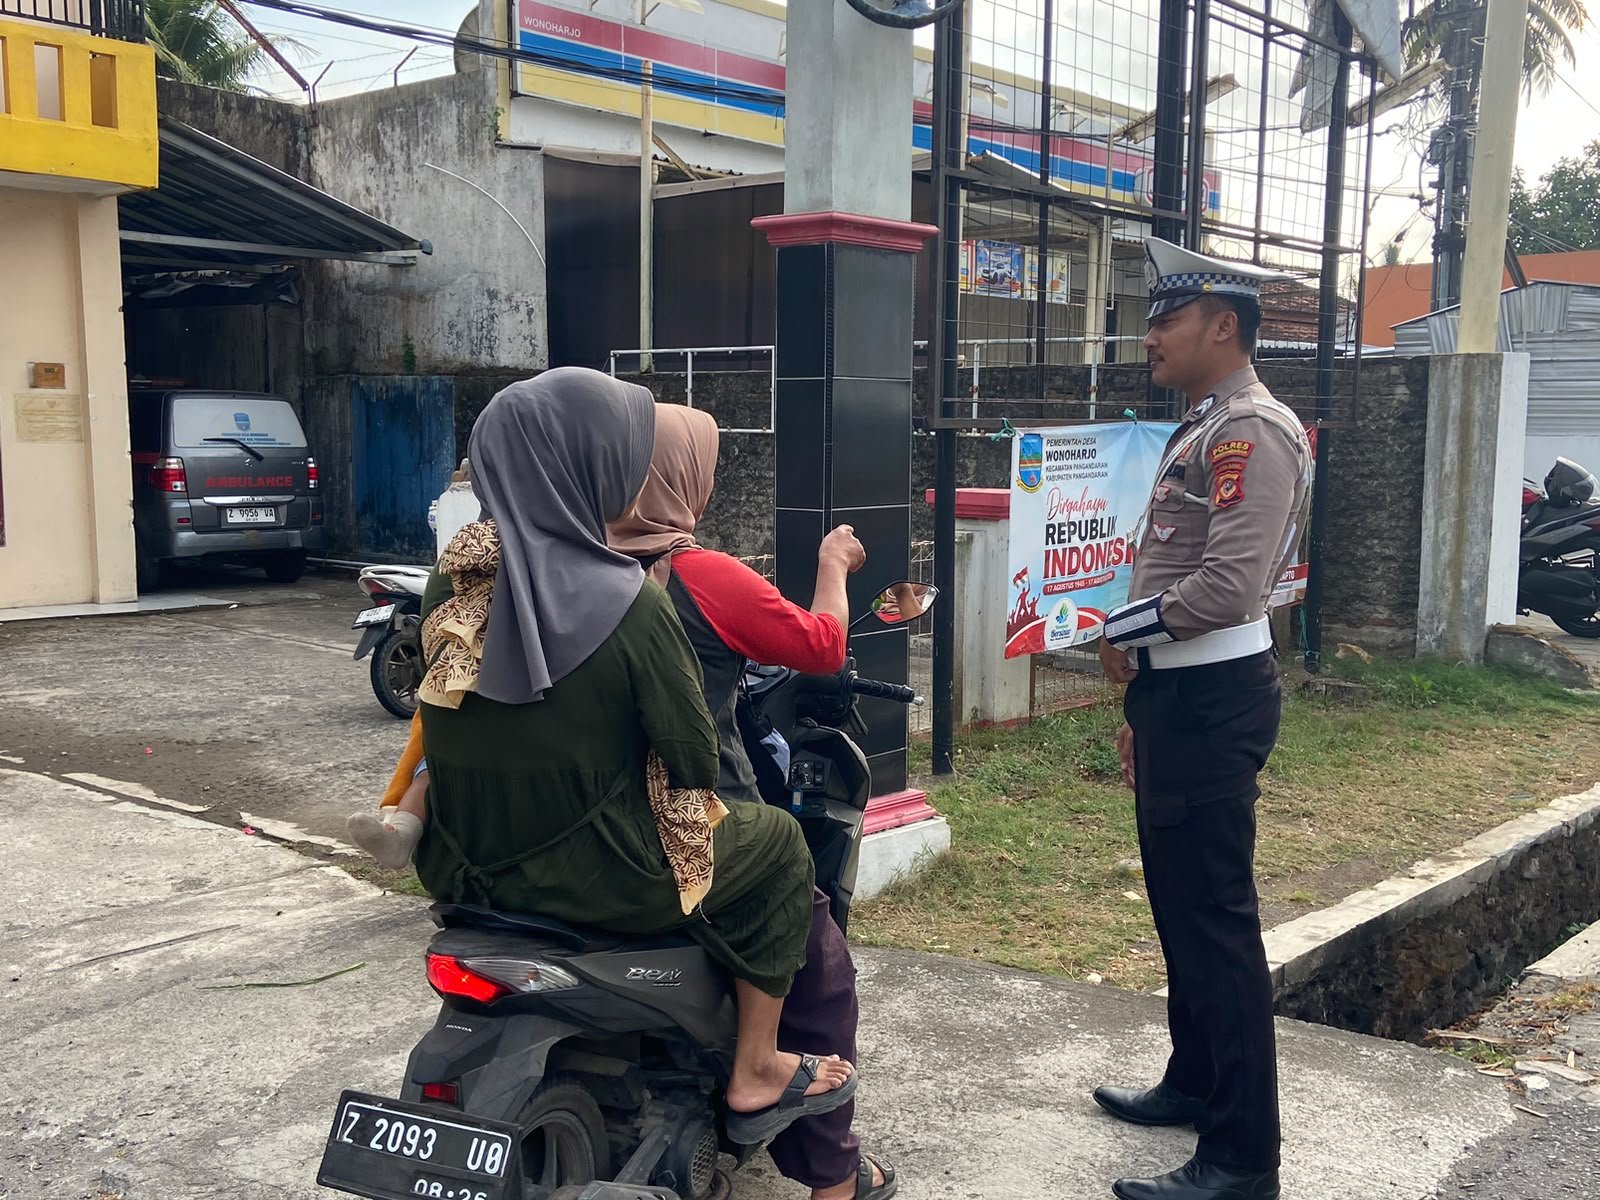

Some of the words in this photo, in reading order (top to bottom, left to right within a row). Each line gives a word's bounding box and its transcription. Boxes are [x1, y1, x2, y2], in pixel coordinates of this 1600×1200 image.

[524, 15, 581, 38] WONOHARJO
[1046, 438, 1081, 447] PEMERINTAH
[1082, 437, 1097, 445] DESA
[1212, 441, 1250, 456] POLRES
[1046, 448, 1097, 462] WONOHARJO
[1046, 464, 1073, 473] KECAMATAN
[1073, 462, 1108, 471] PANGANDARAN
[205, 475, 293, 489] AMBULANCE
[1046, 473, 1072, 482] KABUPATEN
[1073, 471, 1108, 480] PANGANDARAN
[1047, 485, 1109, 521] Dirgahayu
[228, 508, 234, 518] Z
[239, 508, 259, 518] 9956
[1045, 515, 1118, 546] REPUBLIK
[1043, 536, 1134, 580] INDONESI
[1047, 585, 1053, 593] 17
[1053, 581, 1074, 592] AGUSTUS
[1074, 579, 1085, 588] 1945
[445, 1024, 472, 1032] HONDA
[342, 1111, 360, 1143] Z
[369, 1118, 437, 1160] 2093
